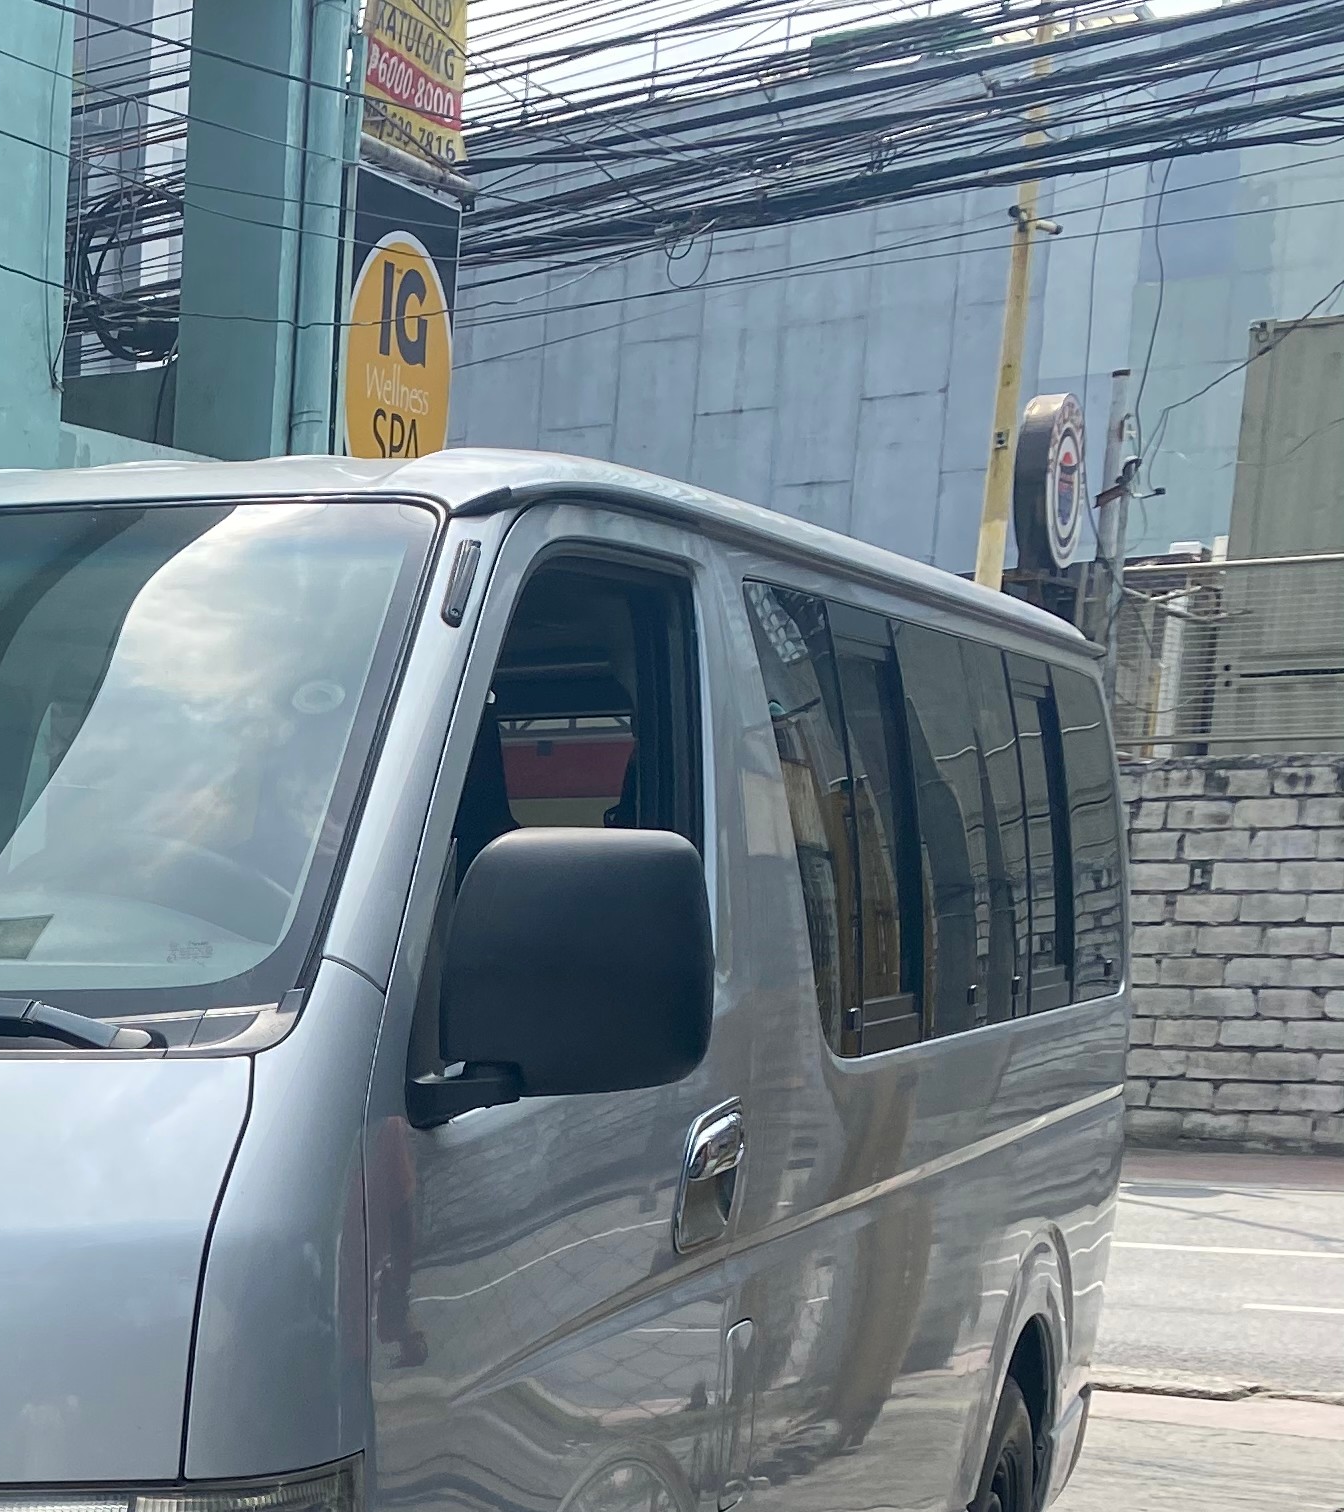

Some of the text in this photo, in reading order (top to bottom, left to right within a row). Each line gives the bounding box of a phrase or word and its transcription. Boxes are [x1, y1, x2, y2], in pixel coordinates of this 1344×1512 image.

[379, 260, 427, 368] IG
[365, 363, 430, 416] Wellness
[372, 407, 419, 458] SPA
